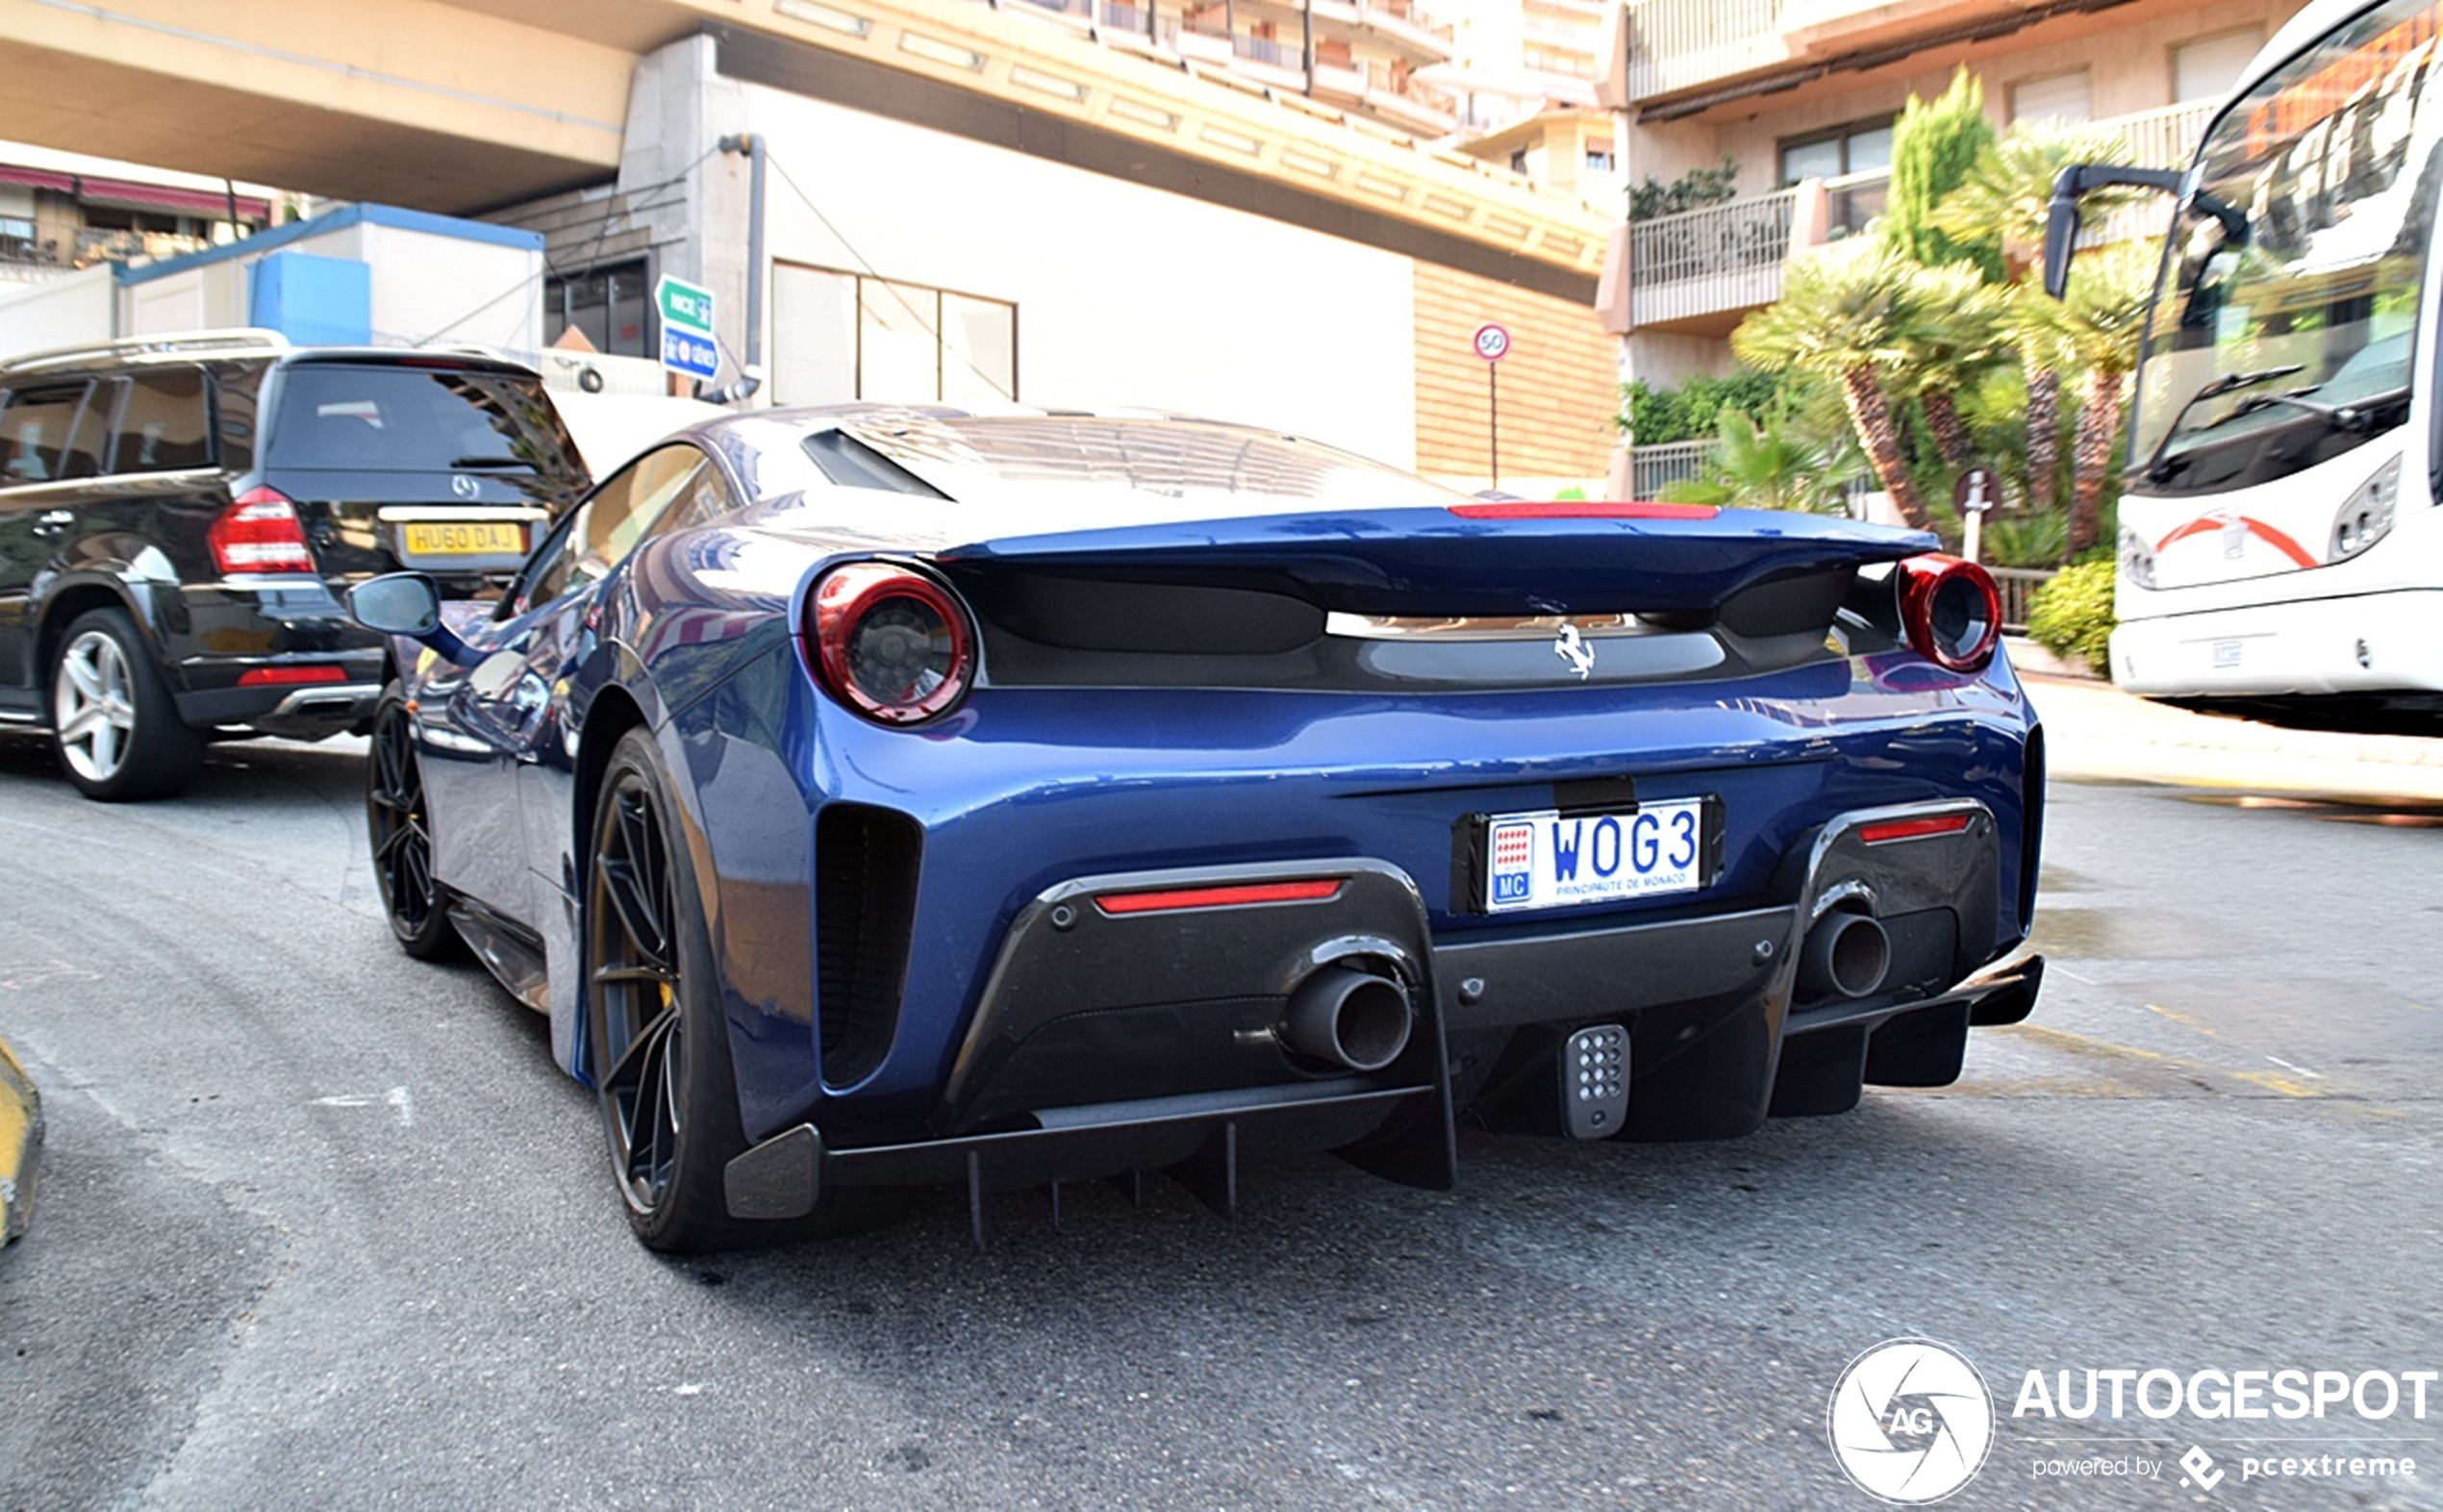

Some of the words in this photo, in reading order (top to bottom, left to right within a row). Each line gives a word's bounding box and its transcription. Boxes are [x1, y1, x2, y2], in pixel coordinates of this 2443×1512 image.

[670, 292, 695, 316] NICE
[1482, 334, 1504, 350] 50
[415, 526, 467, 550] HU60
[475, 525, 513, 548] DAJ
[1499, 874, 1524, 896] MC
[1626, 877, 1640, 890] DE
[1644, 873, 1686, 887] MONACO
